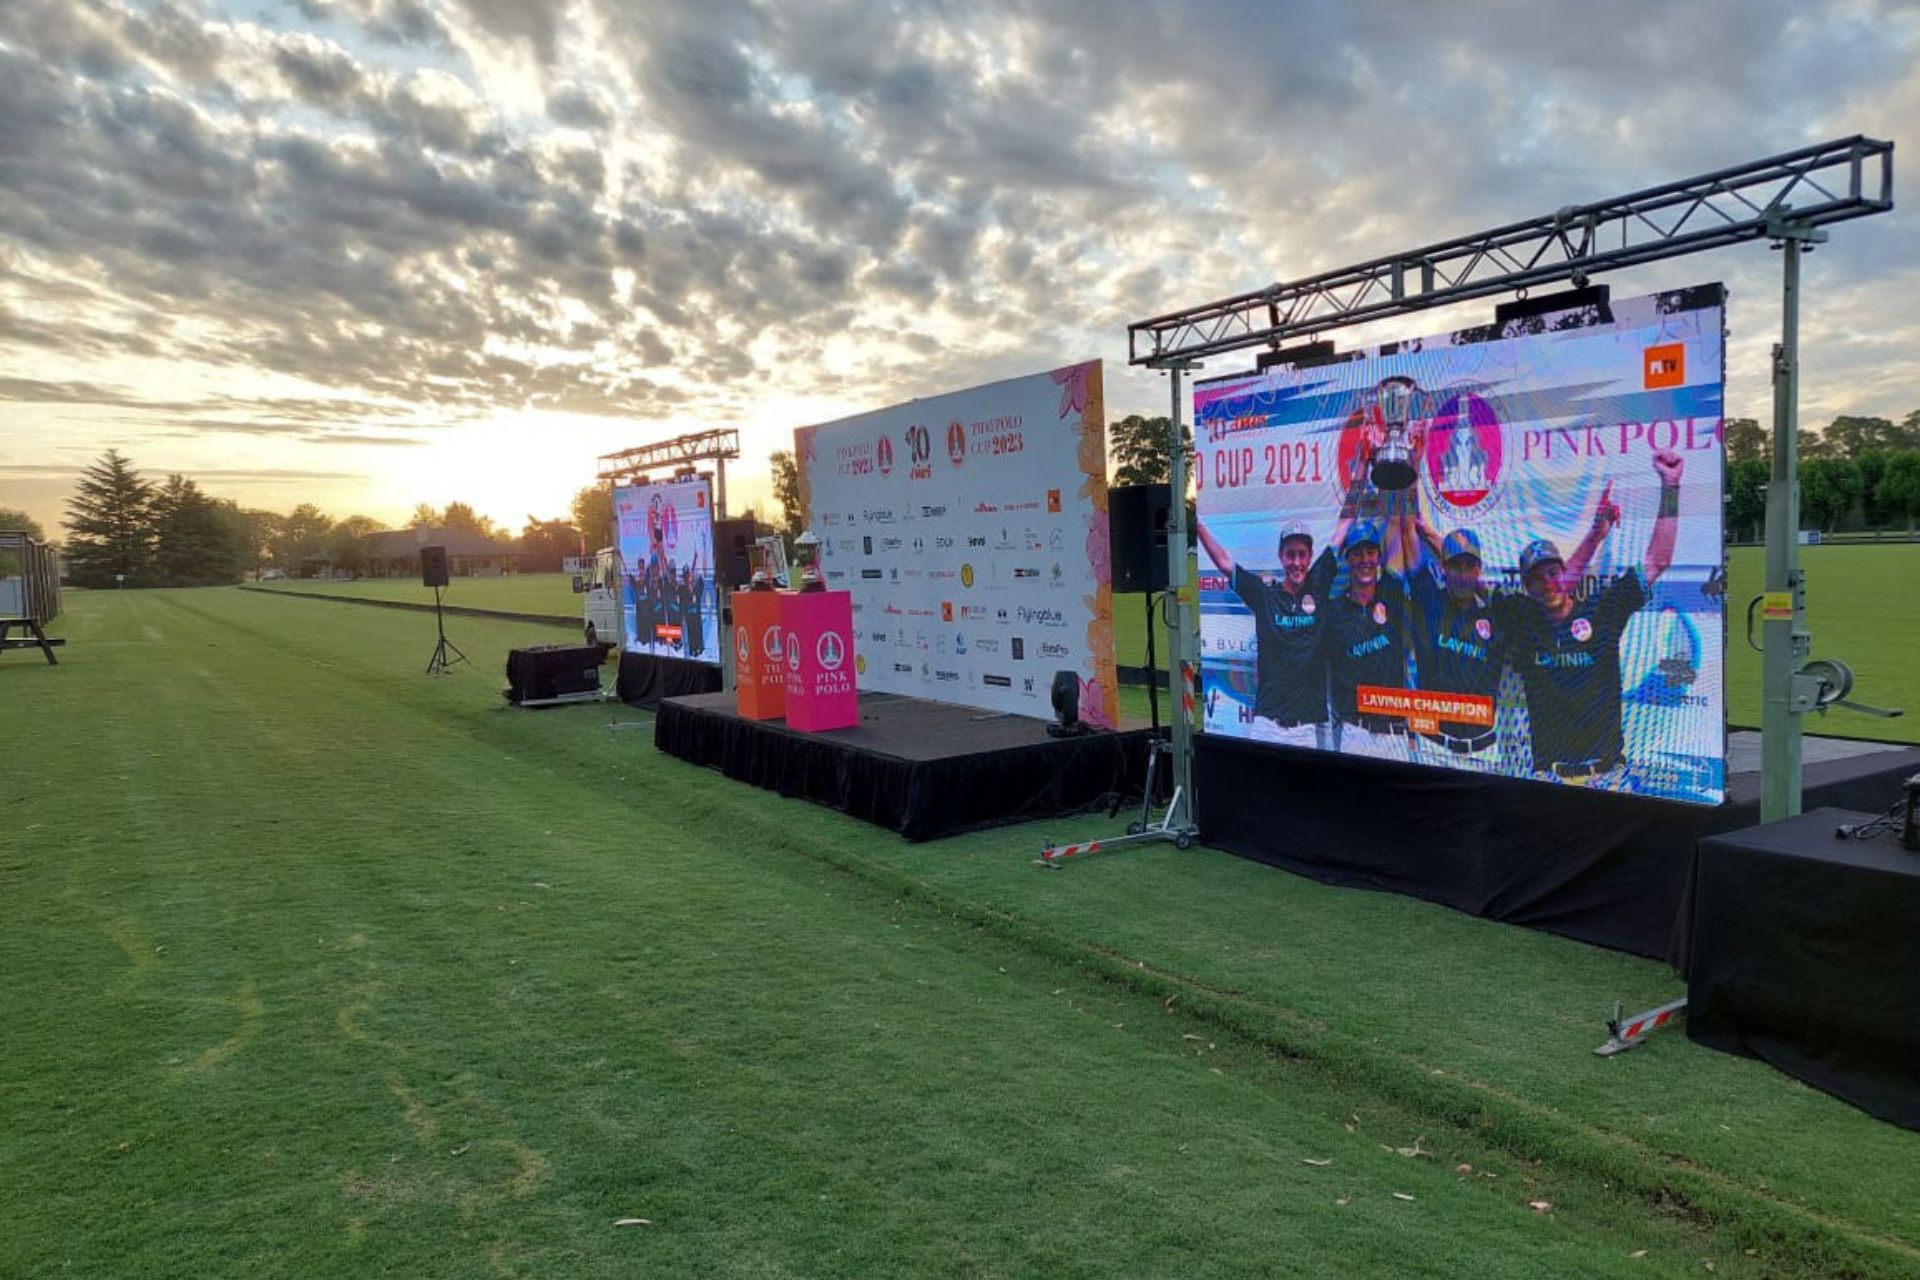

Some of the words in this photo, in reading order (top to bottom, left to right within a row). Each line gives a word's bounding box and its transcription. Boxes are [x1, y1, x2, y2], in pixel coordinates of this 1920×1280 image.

[1523, 424, 1605, 461] PINK
[1619, 415, 1722, 454] POL
[1215, 448, 1253, 489] CUP
[1265, 441, 1322, 484] 2021
[816, 672, 847, 683] PINK
[816, 683, 850, 695] POLO
[1363, 694, 1411, 709] LAVINIA
[1413, 698, 1488, 718] CHAMPION
